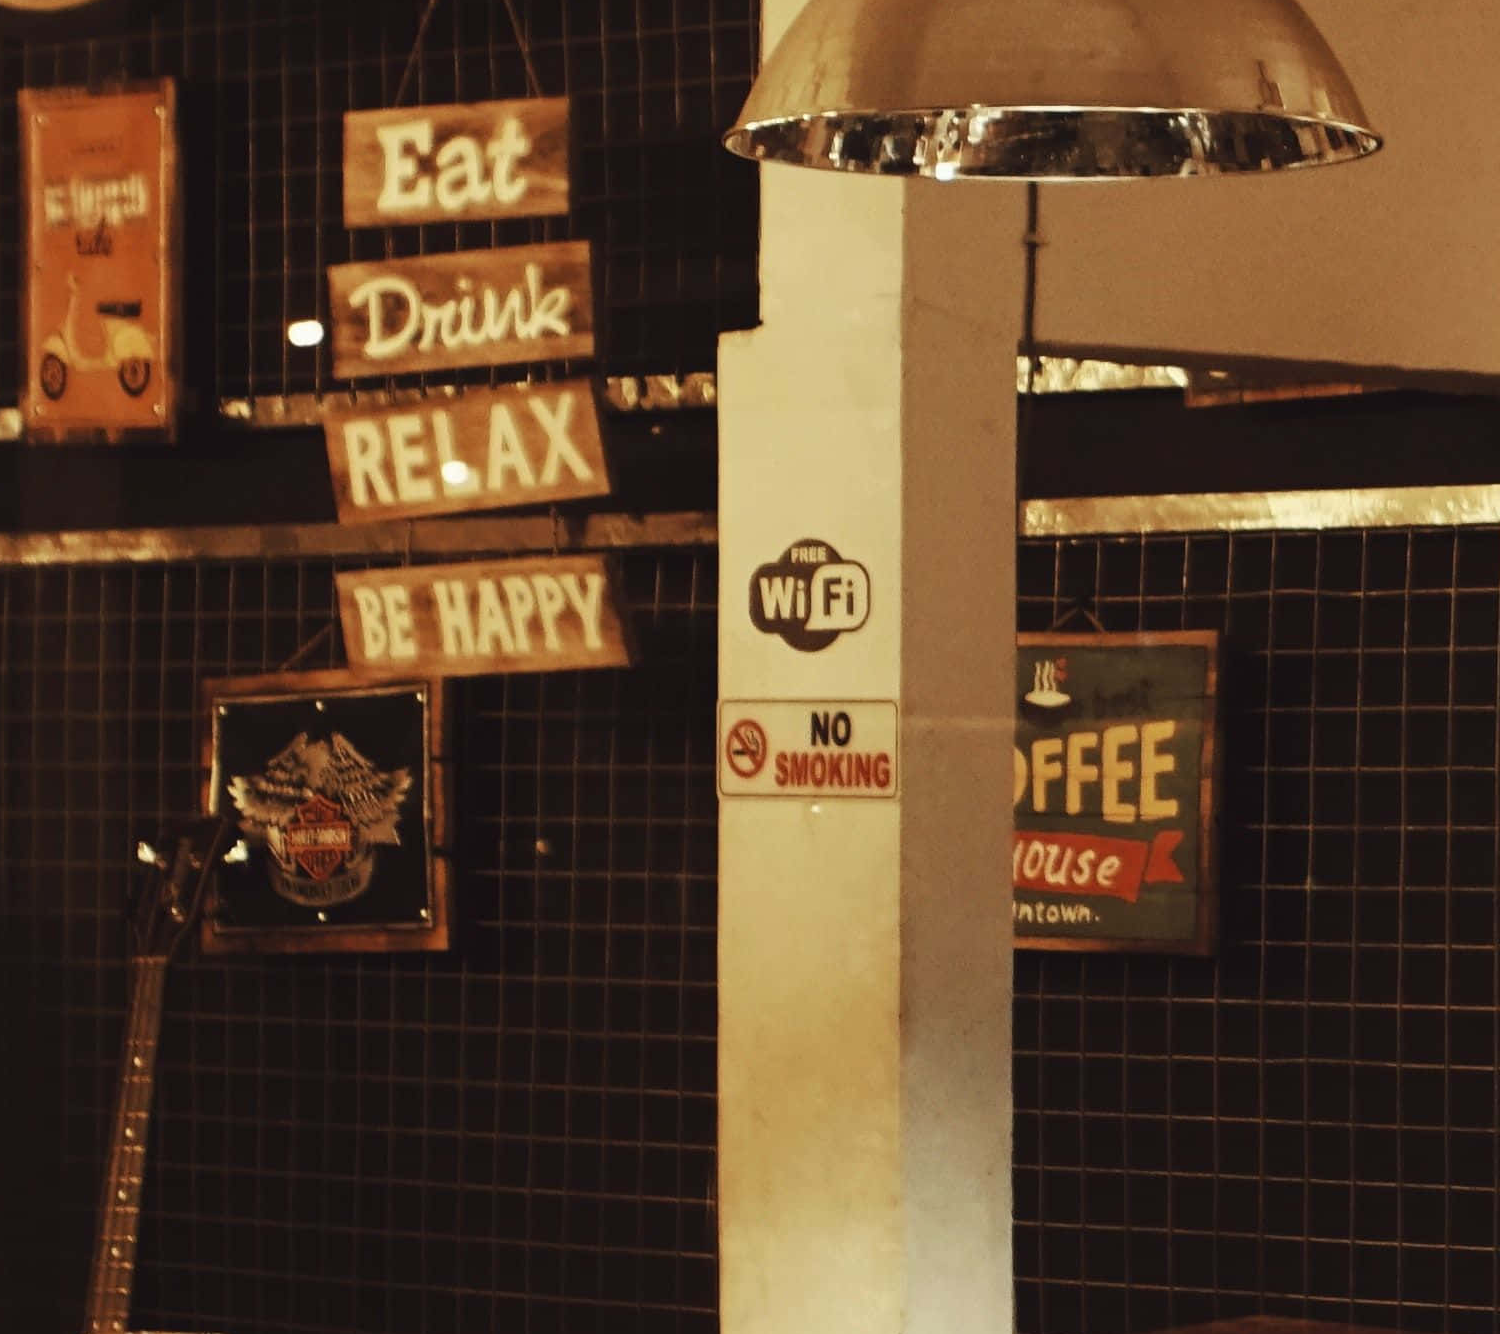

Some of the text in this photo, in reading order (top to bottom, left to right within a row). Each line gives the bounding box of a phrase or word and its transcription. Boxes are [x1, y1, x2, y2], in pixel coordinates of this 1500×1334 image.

[375, 114, 535, 213] Eat
[347, 264, 572, 362] Drink
[343, 392, 598, 508] RELAX
[789, 546, 827, 564] FREE
[352, 572, 606, 661] BE HAPPY
[757, 574, 857, 621] WiFi
[809, 710, 852, 747] NO
[774, 752, 891, 790] SMOKING
[1014, 720, 1180, 824] FFEE
[1013, 898, 1102, 924] ntown.
